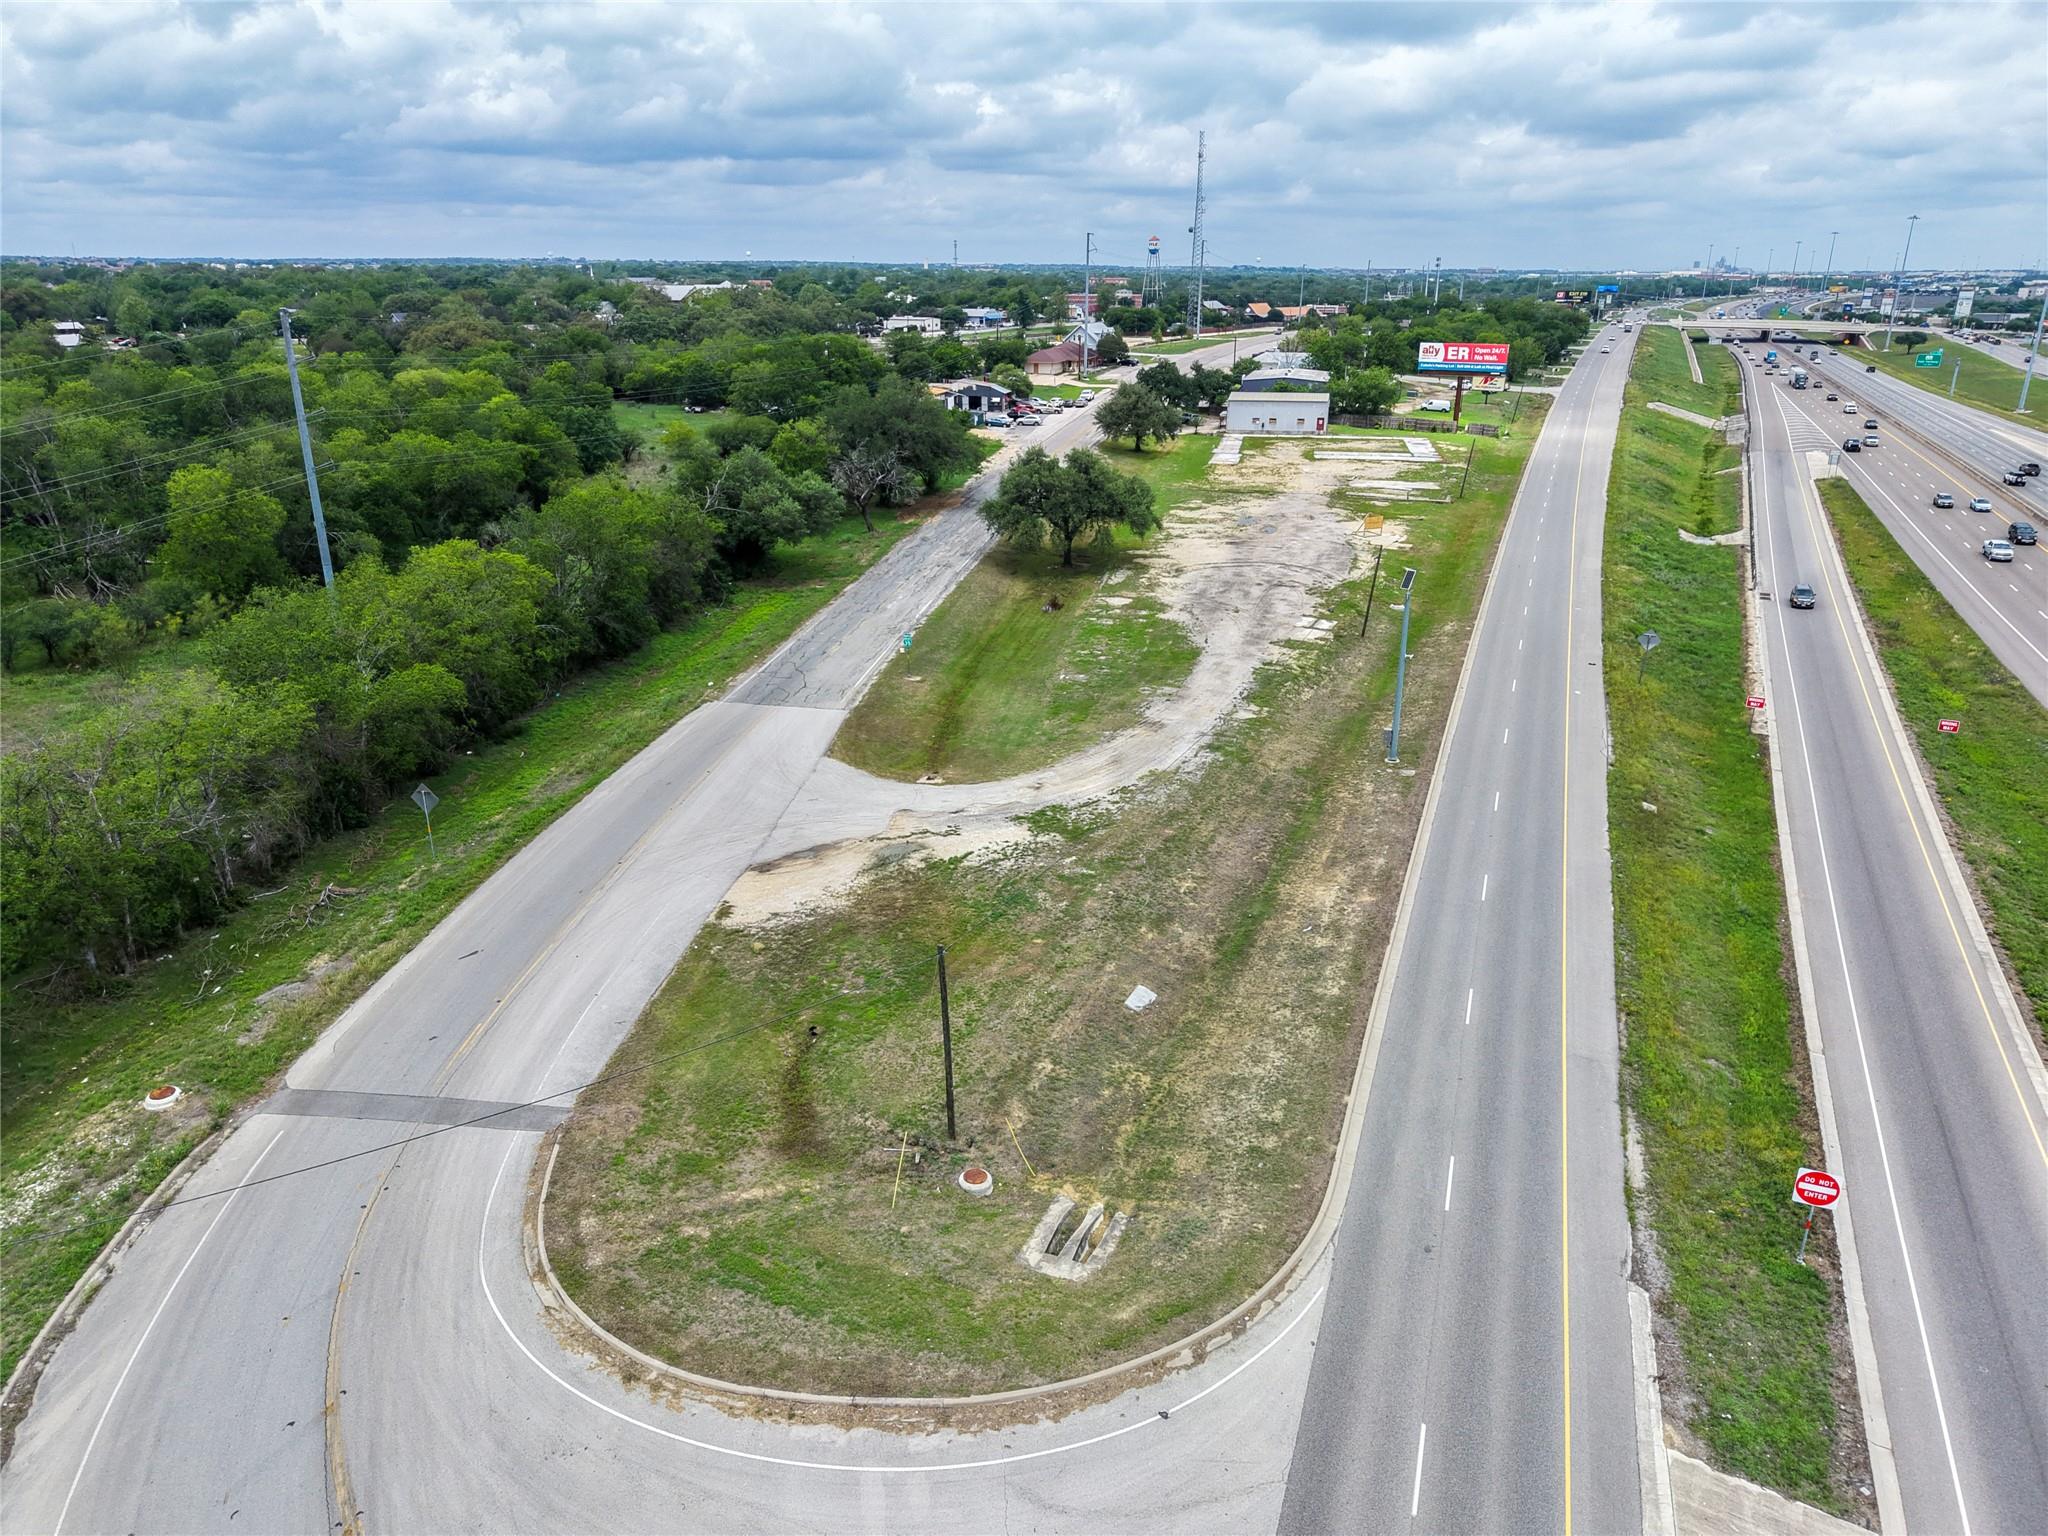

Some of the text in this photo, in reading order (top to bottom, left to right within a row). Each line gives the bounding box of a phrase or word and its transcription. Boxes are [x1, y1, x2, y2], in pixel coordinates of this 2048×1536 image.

[1422, 345, 1440, 356] ally
[1447, 346, 1470, 360] ER
[1804, 1191, 1828, 1200] ENTER
